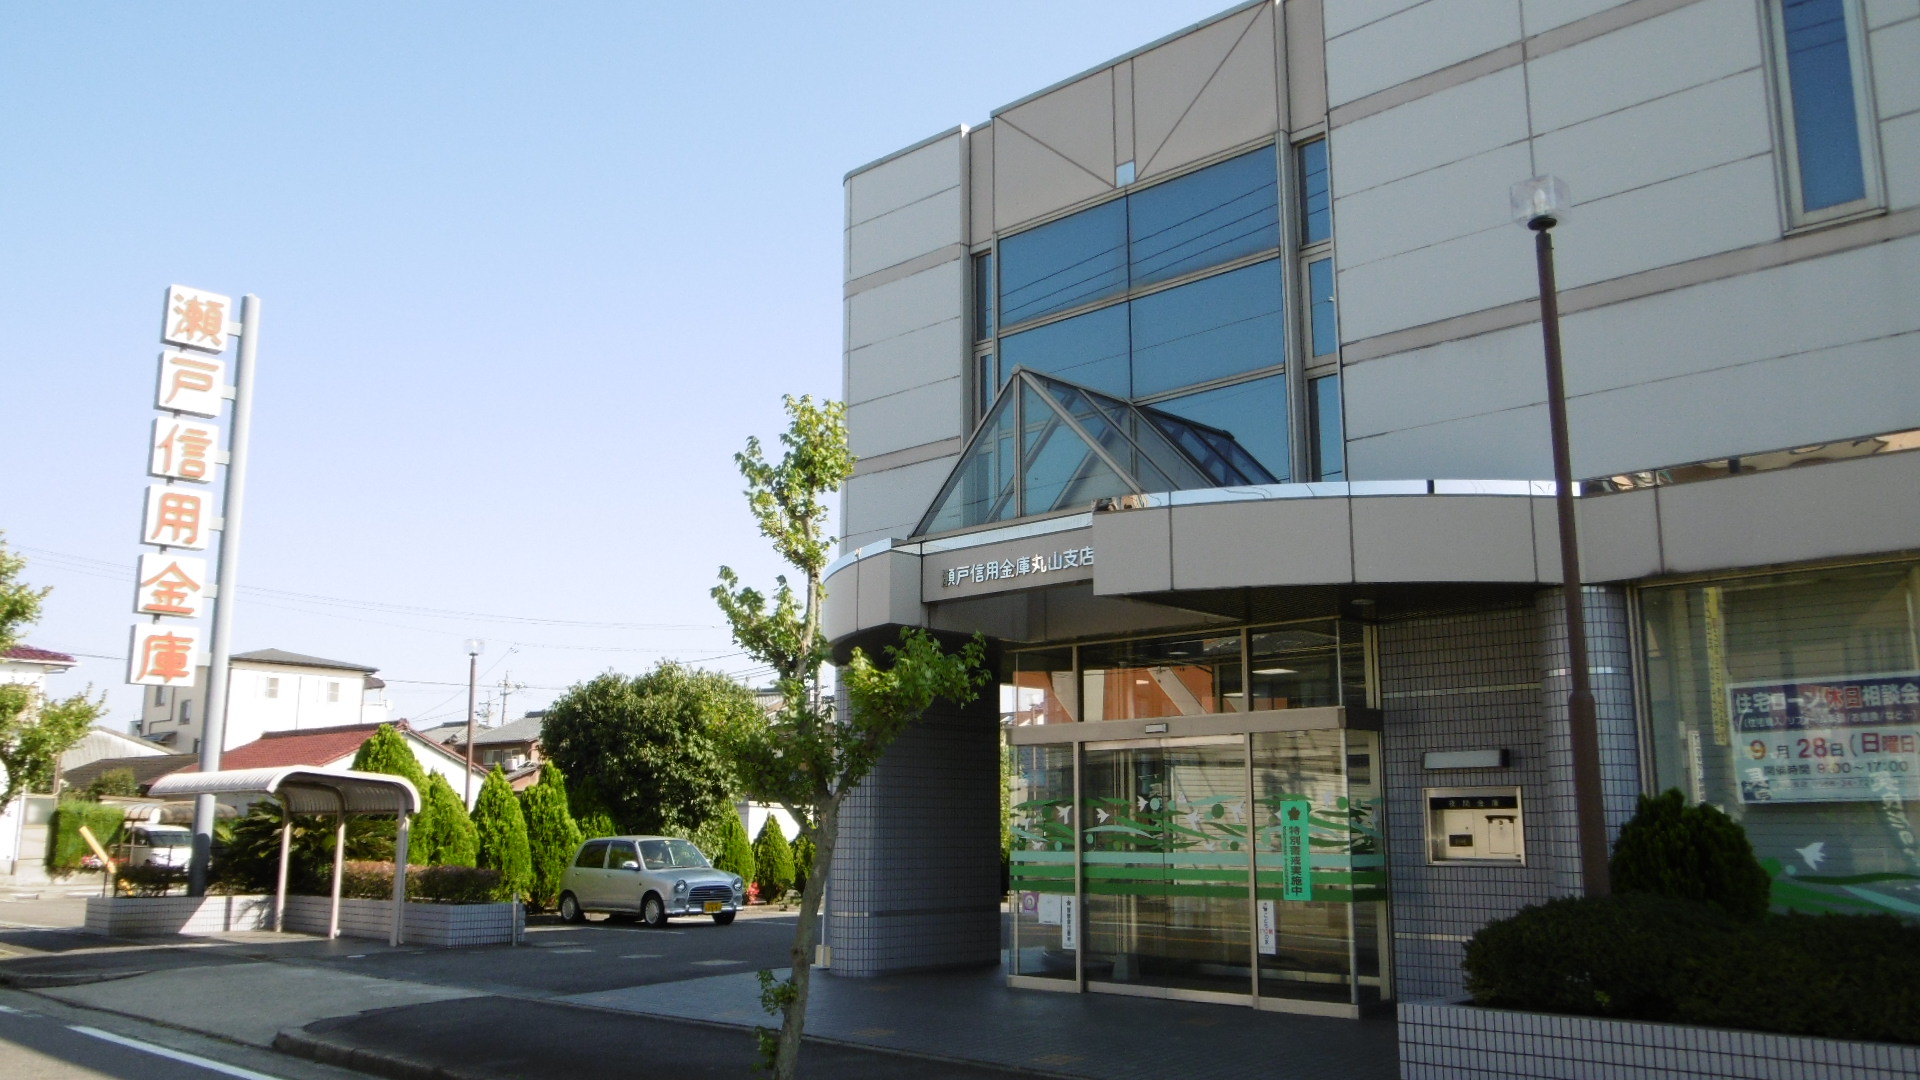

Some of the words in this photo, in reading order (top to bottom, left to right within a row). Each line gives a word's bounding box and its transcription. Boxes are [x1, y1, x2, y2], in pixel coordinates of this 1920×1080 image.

[137, 293, 225, 682] 瀬戸信用金庫
[942, 546, 1094, 588] 瀬戸信用金庫丸山支店
